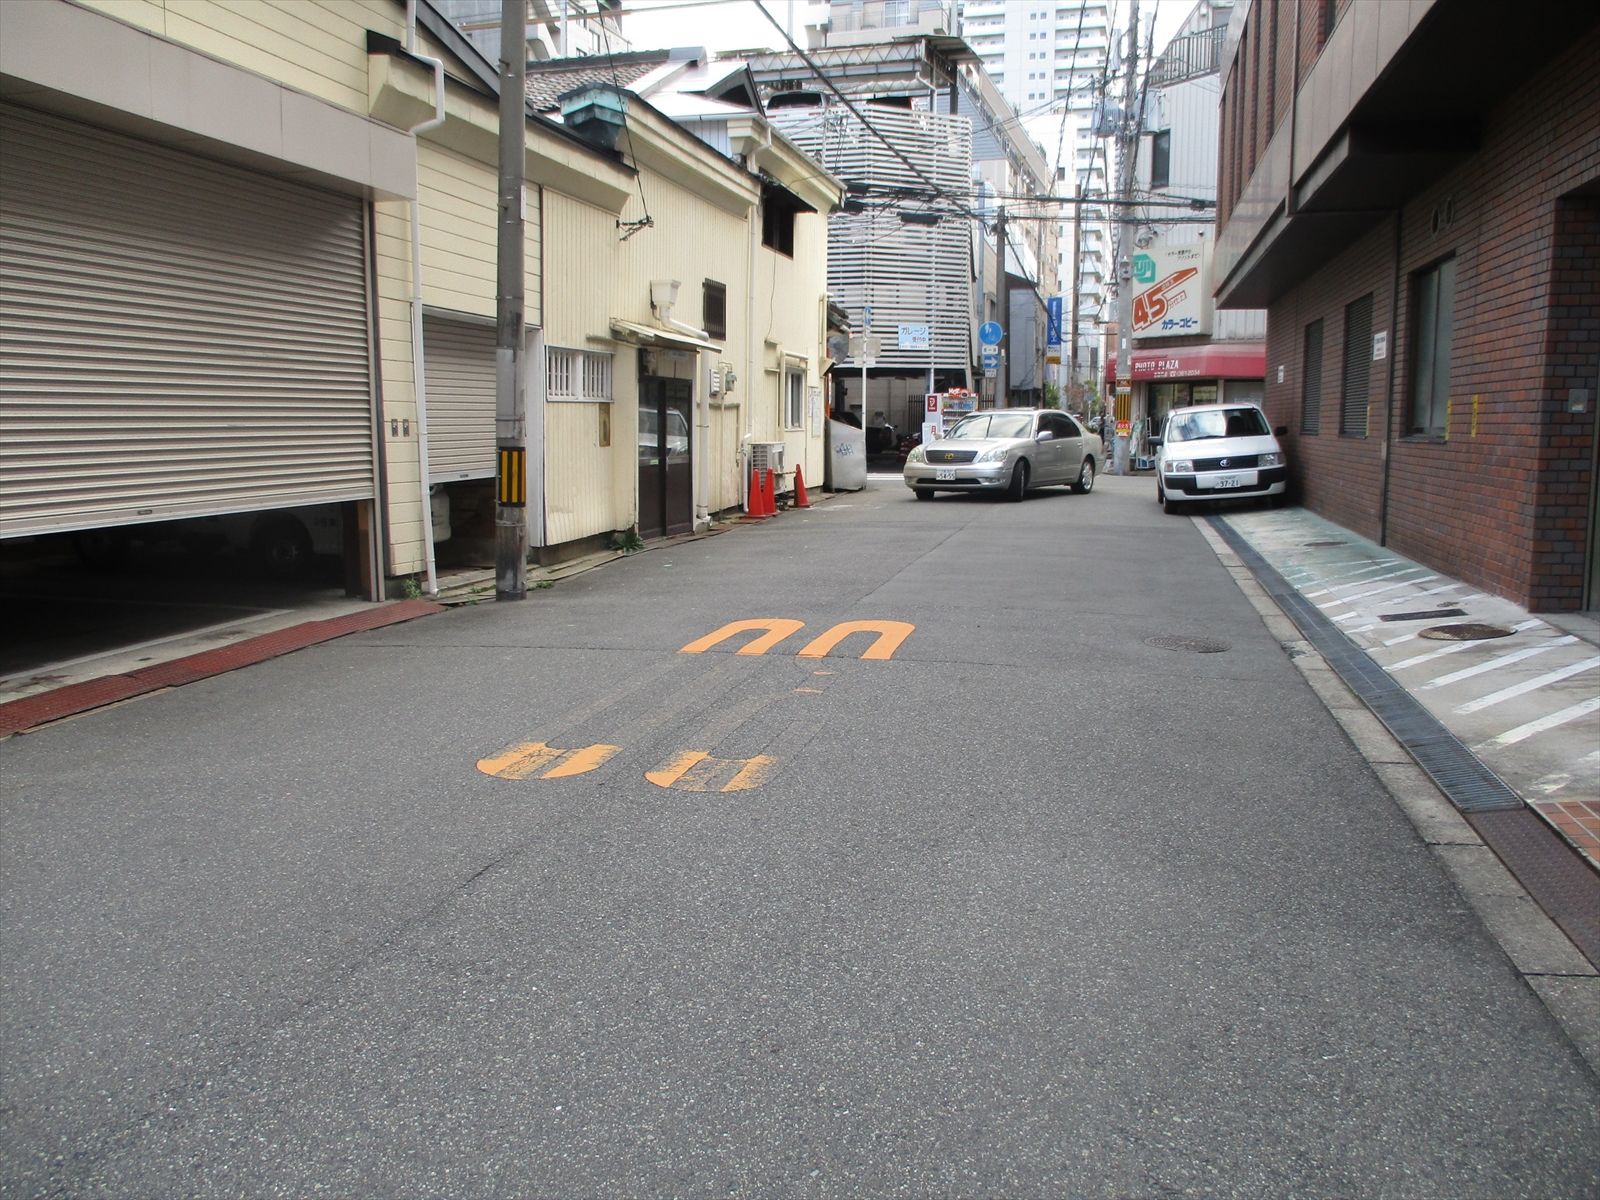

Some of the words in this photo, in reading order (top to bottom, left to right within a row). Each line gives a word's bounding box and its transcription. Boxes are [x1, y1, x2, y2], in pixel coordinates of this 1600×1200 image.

[1161, 317, 1199, 330] カラーコピー
[901, 327, 926, 336] ガレージ
[1135, 361, 1155, 372] PHOTO
[1158, 359, 1179, 371] PLAZA
